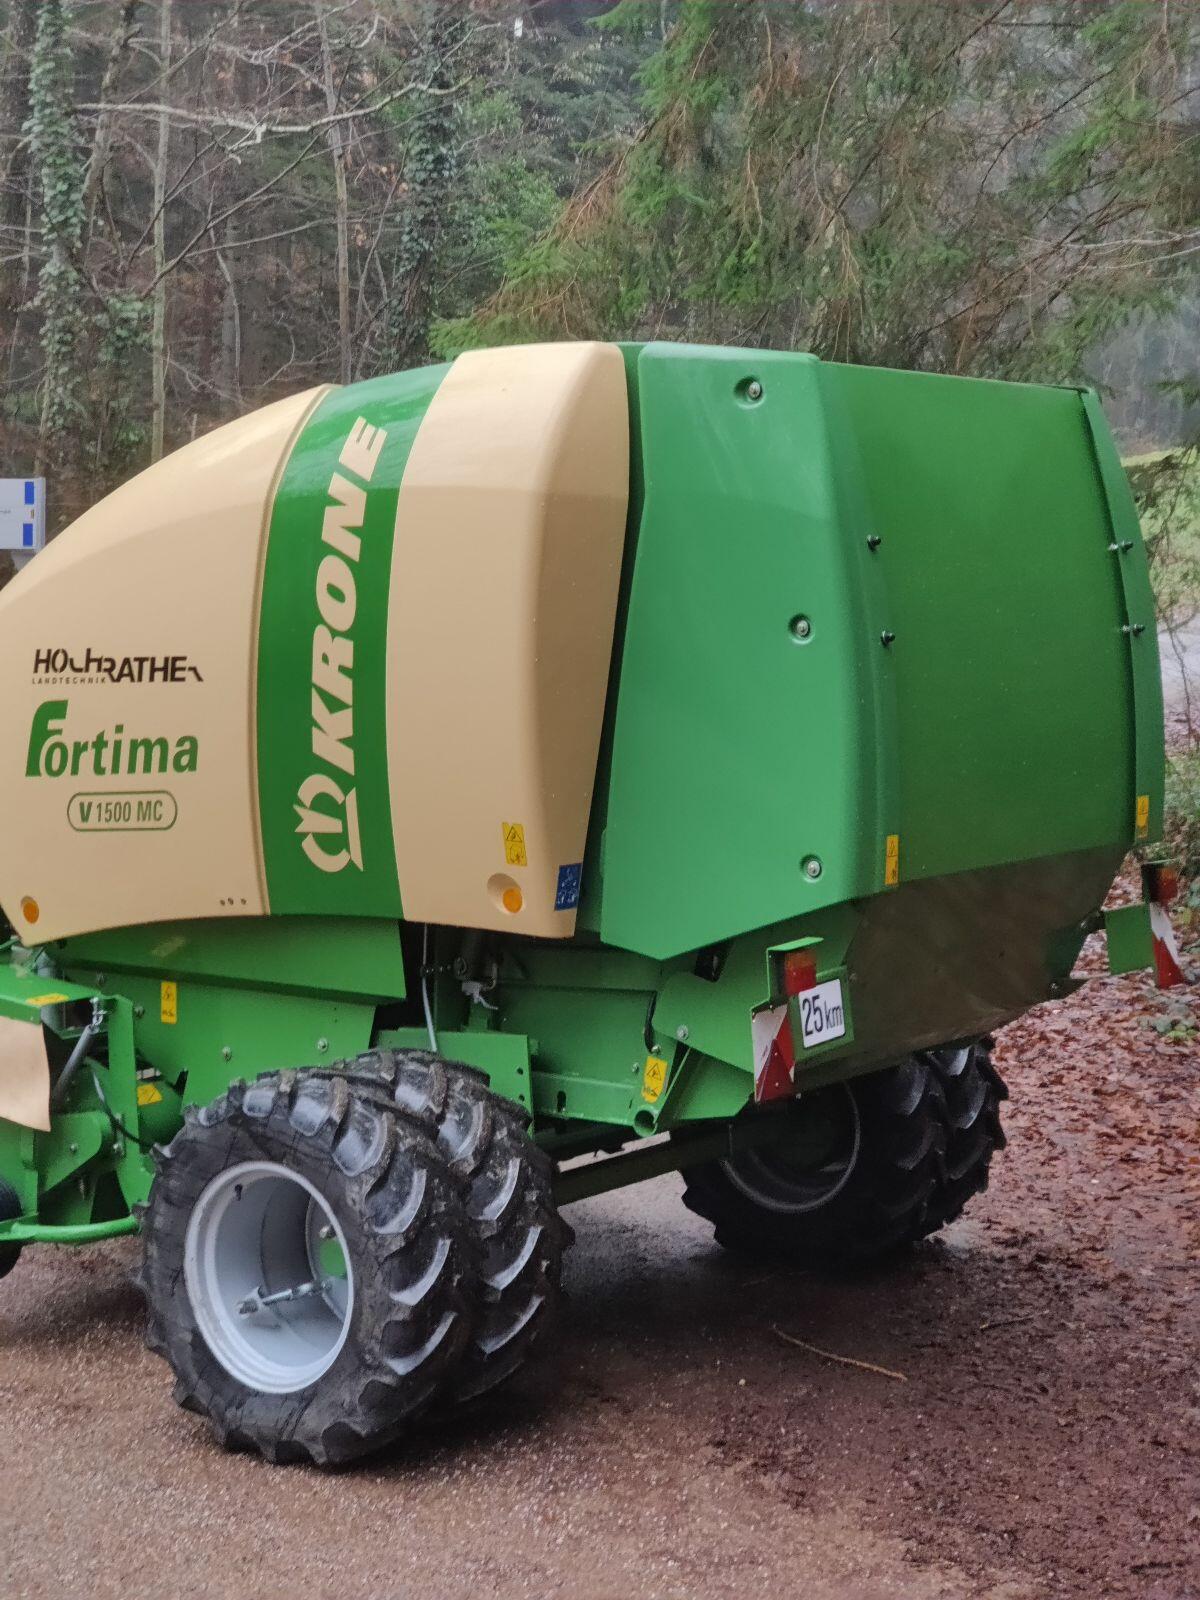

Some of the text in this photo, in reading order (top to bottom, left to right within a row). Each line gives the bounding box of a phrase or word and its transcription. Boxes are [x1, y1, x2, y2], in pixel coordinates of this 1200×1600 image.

[312, 416, 388, 776] KRONE
[32, 677, 106, 685] LANDTECHNIK
[25, 699, 199, 777] Fortima
[79, 800, 163, 823] V 1500 MC
